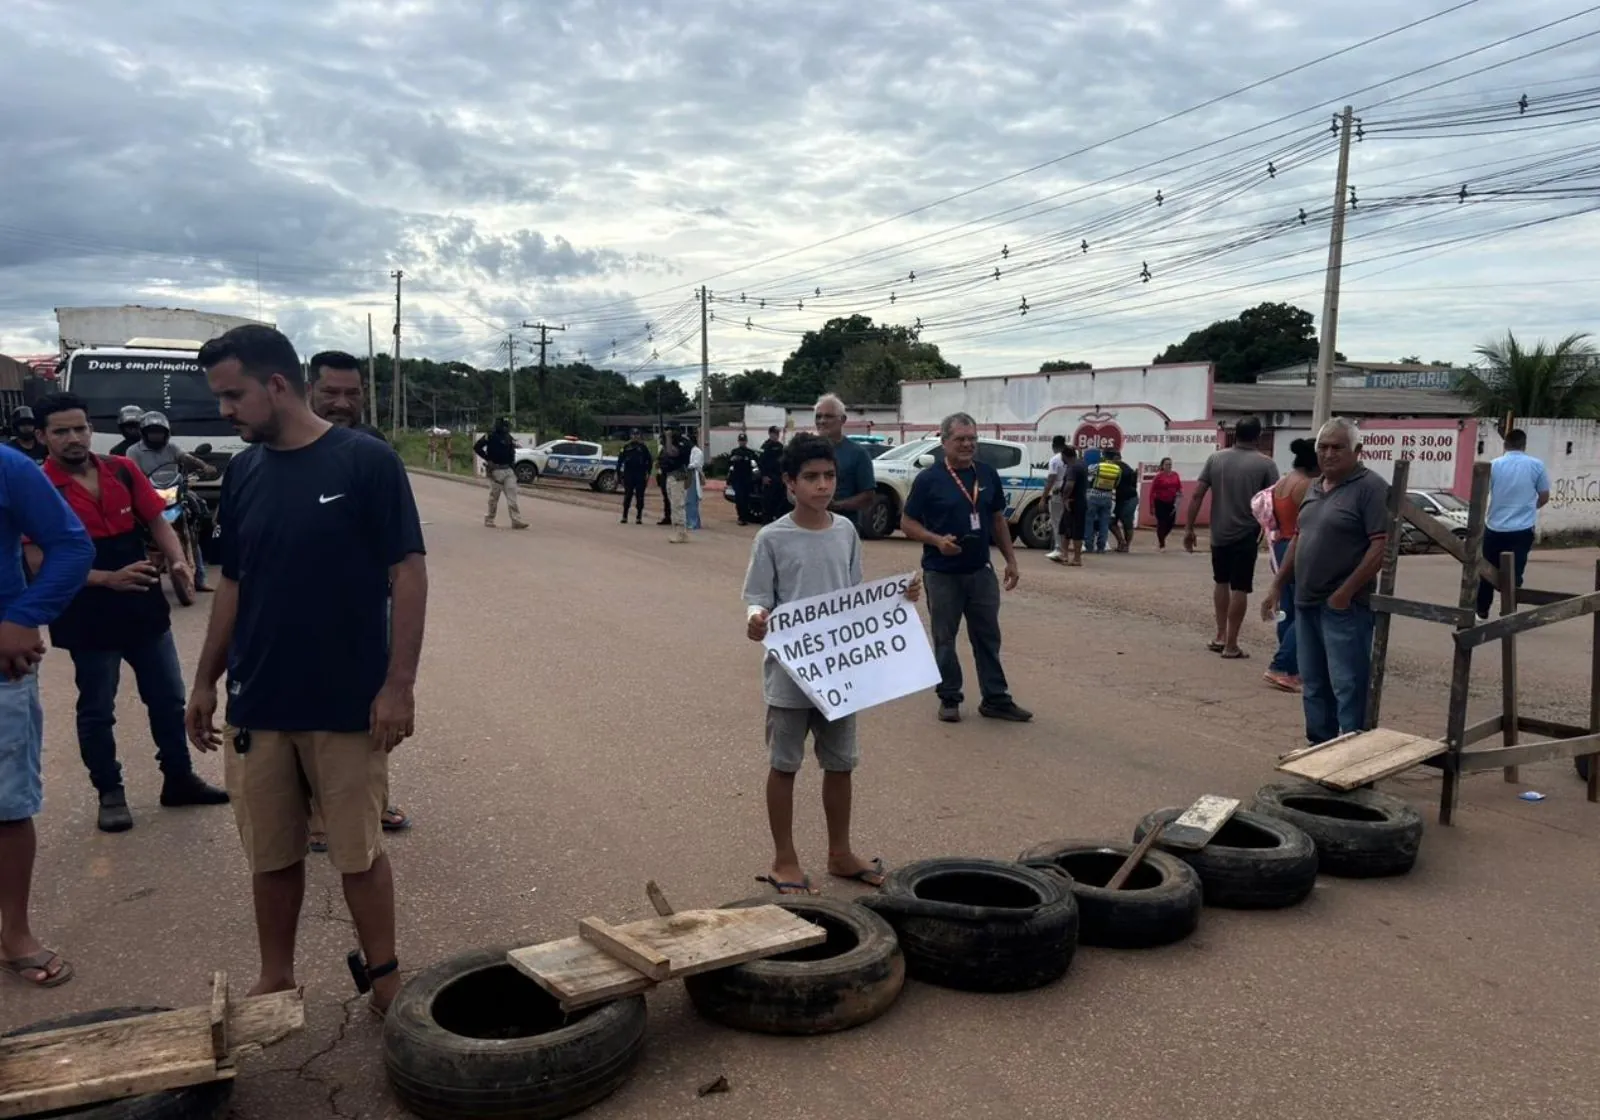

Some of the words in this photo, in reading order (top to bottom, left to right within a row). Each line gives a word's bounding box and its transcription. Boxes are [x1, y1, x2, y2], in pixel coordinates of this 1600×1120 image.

[88, 360, 121, 370] Deus
[1372, 372, 1448, 388] TORNEARIA
[1079, 434, 1115, 448] Belles
[1361, 432, 1395, 446] RÍODO
[1420, 435, 1453, 447] 30,00
[1359, 449, 1393, 461] RNOITE
[1419, 451, 1452, 462] 40,00
[769, 578, 907, 633] TRABALHAMOS
[783, 633, 825, 661] MÊS
[828, 616, 879, 647] TODO
[883, 603, 907, 629] SÓ
[825, 640, 888, 674] PAGAR
[891, 634, 907, 652] O
